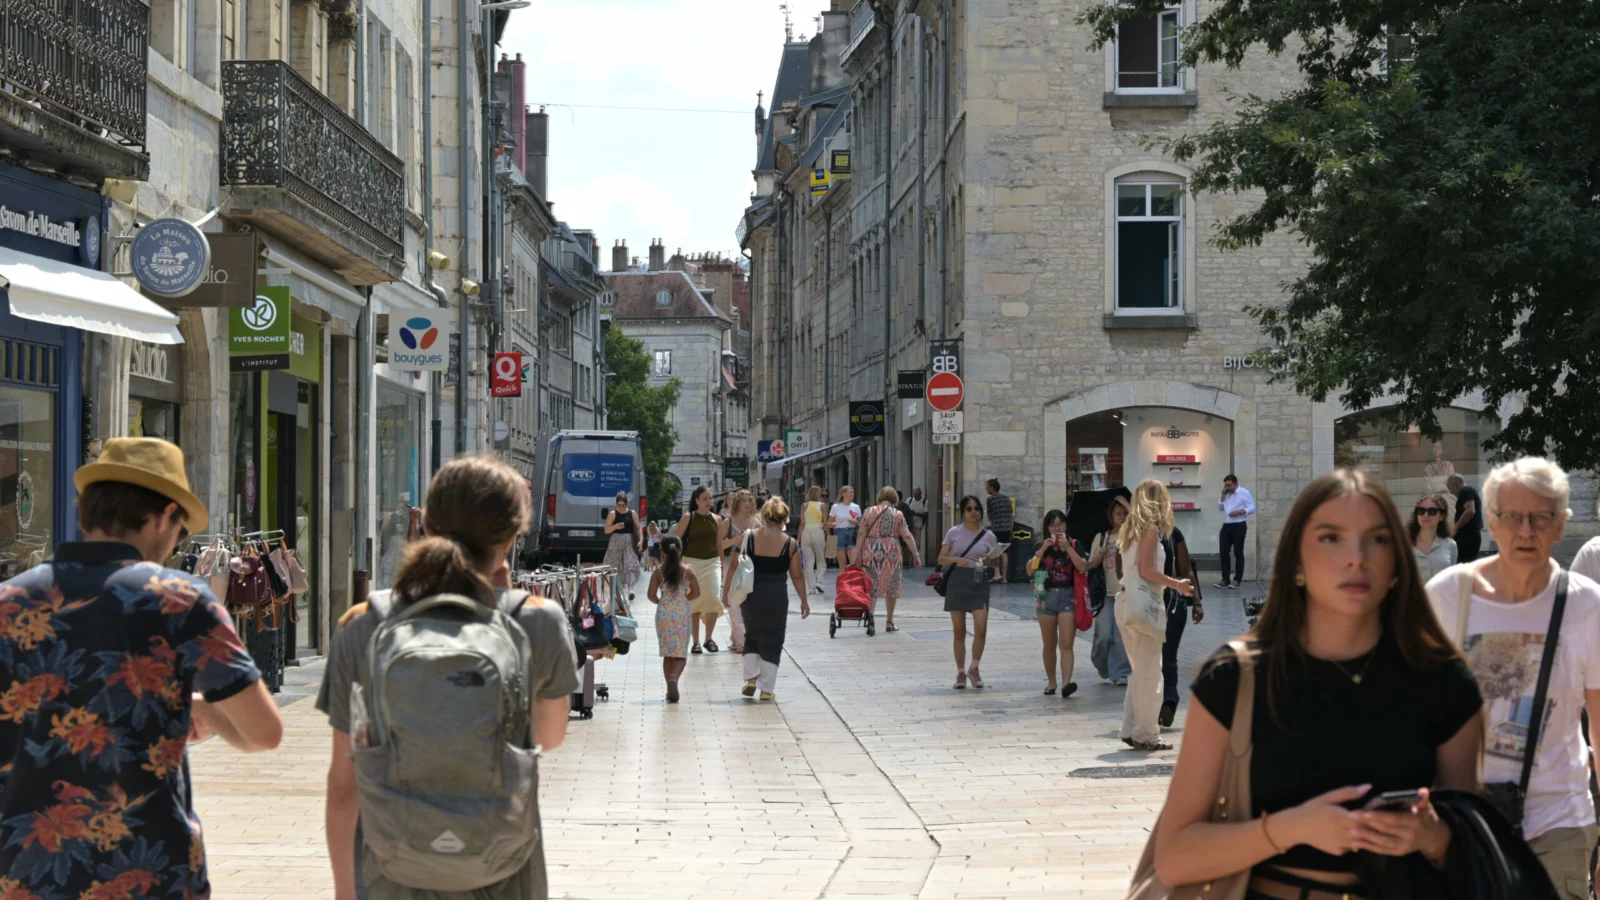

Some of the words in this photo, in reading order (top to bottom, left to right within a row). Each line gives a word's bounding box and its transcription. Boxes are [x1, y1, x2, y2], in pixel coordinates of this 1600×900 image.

[0, 205, 26, 232] Savon
[27, 210, 39, 236] de
[38, 214, 80, 247] Marseille
[150, 231, 161, 241] La
[162, 228, 192, 246] Maison
[140, 255, 146, 266] du
[142, 265, 160, 284] Savon
[170, 260, 197, 285] Marseille
[160, 278, 170, 286] de
[242, 359, 278, 367] L'INSTITUT
[394, 352, 442, 365] bouygues
[495, 384, 517, 394] Quick
[571, 470, 593, 478] PVC
